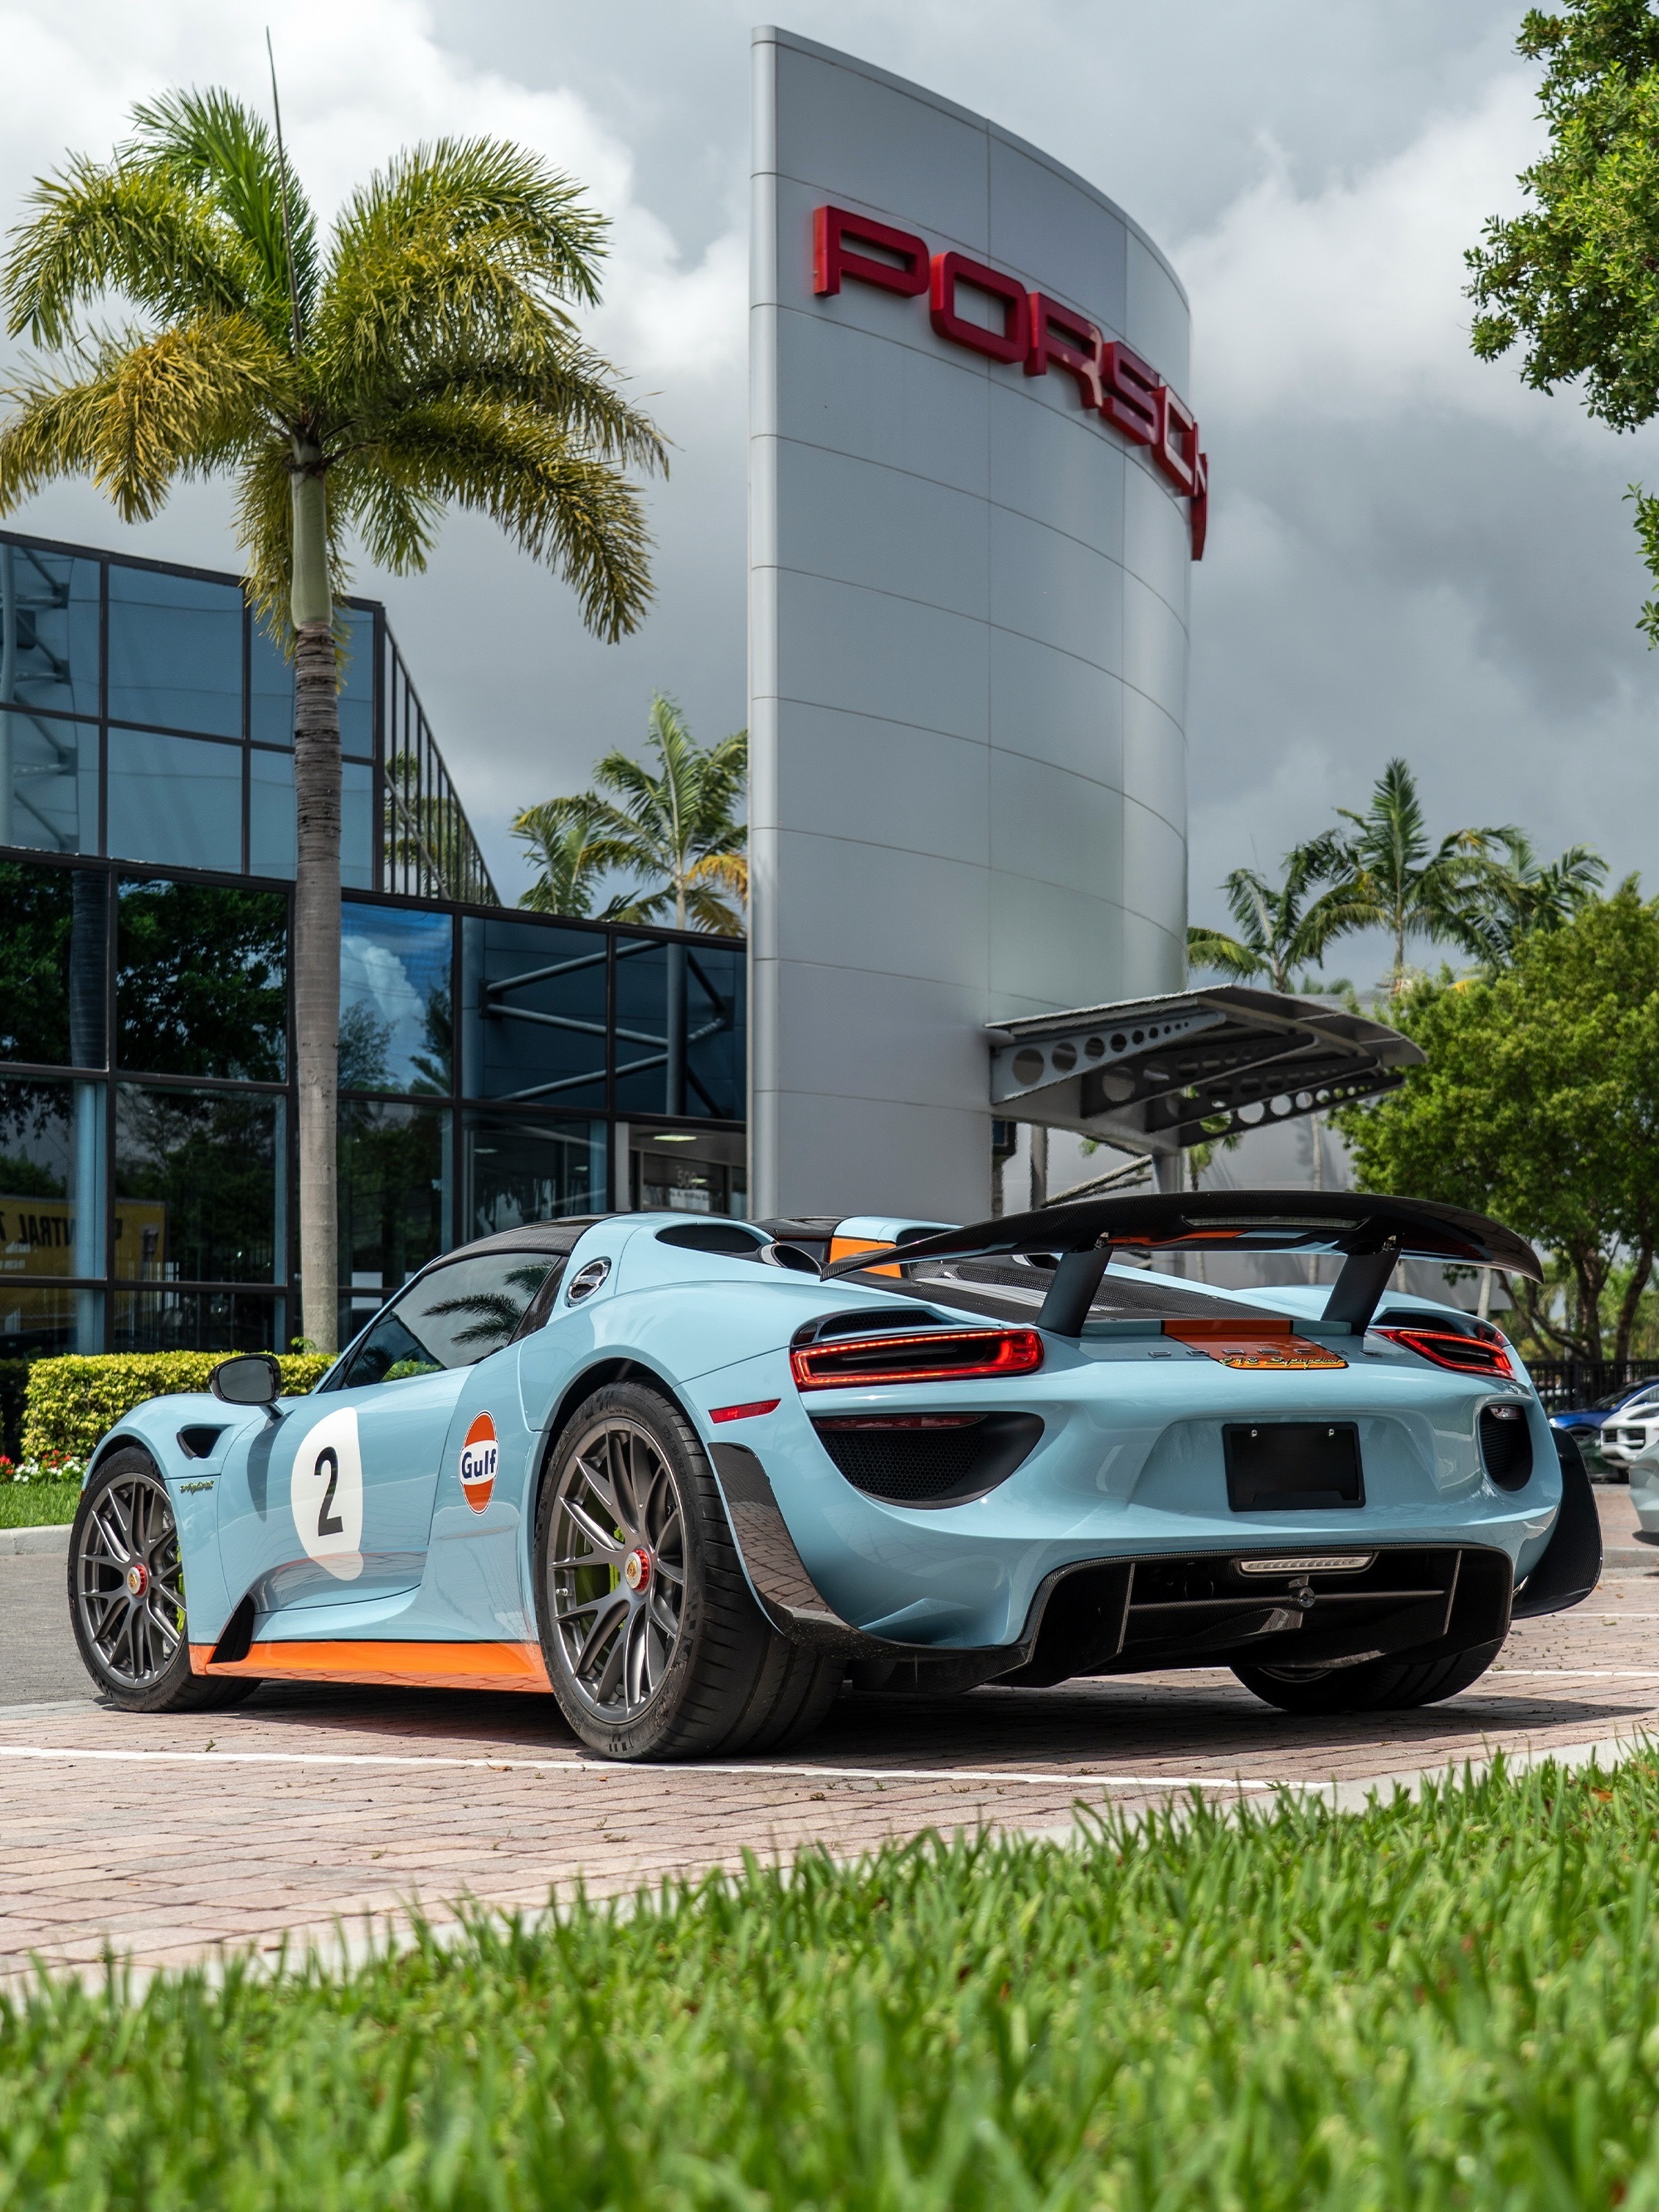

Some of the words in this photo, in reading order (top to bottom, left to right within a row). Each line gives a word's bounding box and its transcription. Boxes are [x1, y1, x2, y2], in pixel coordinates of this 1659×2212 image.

[814, 205, 1208, 561] PORSC
[314, 1446, 345, 1537] 2
[461, 1449, 496, 1479] Gulf
